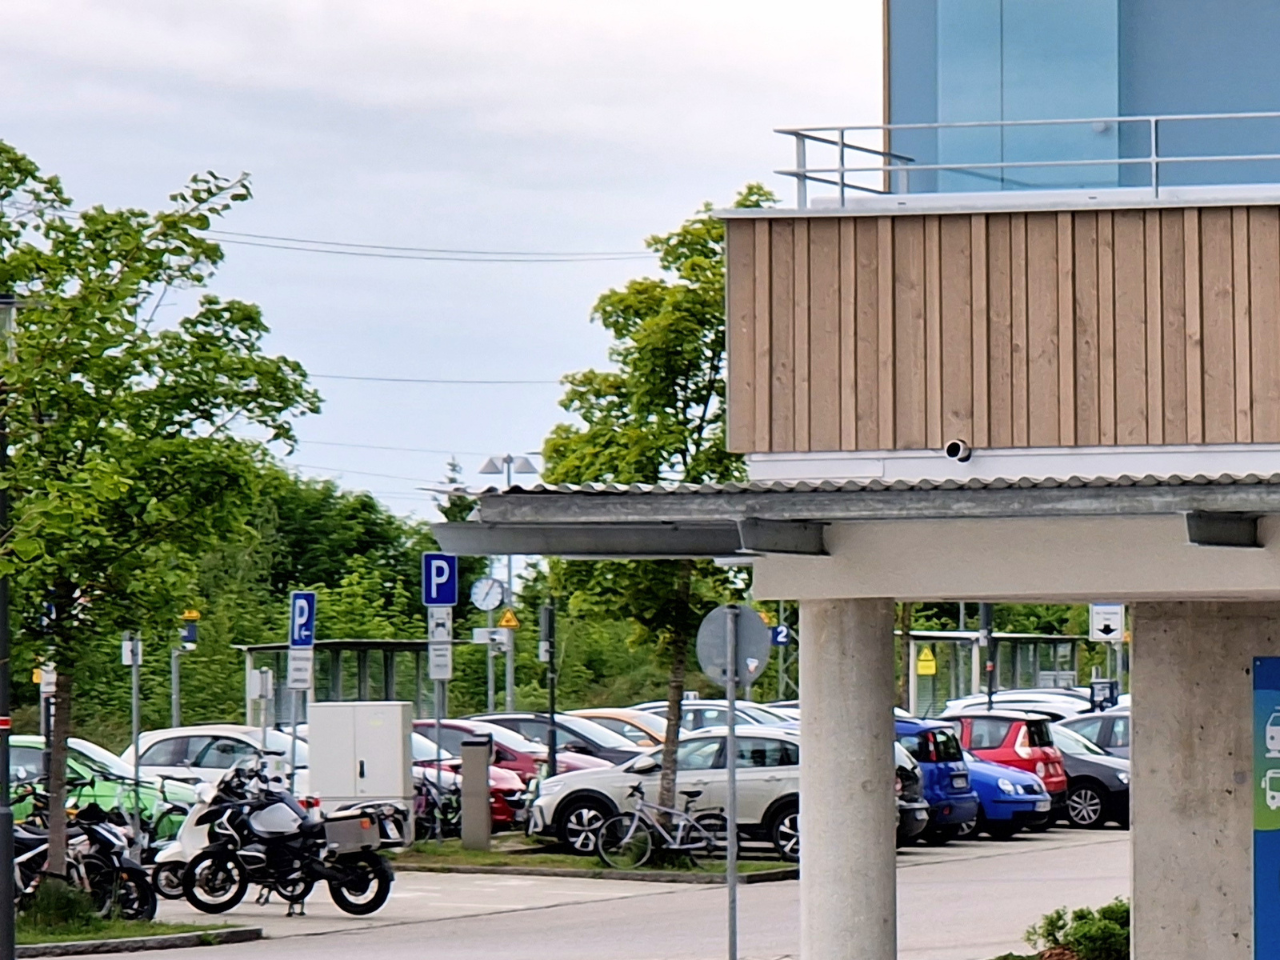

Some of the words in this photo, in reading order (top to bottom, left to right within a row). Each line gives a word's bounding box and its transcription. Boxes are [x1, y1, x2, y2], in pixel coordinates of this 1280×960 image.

[431, 559, 450, 598] P
[294, 598, 308, 640] P
[777, 625, 788, 642] 2
